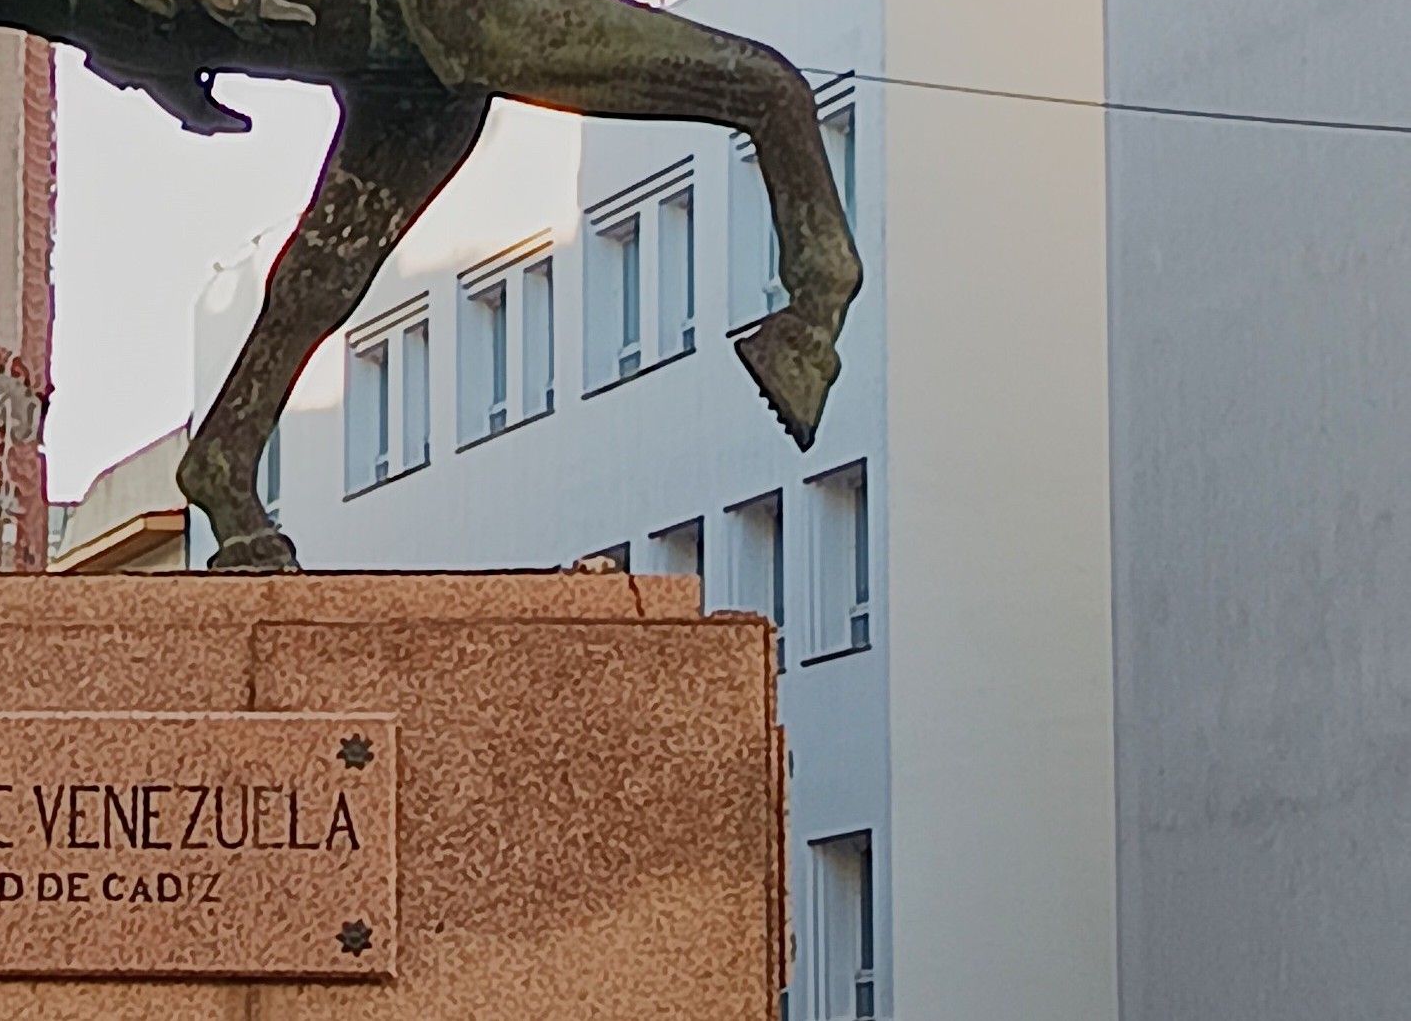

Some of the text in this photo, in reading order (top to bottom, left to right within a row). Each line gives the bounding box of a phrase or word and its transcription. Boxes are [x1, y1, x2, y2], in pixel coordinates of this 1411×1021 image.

[33, 785, 360, 850] VENEZUELA
[37, 872, 90, 902] DE
[102, 872, 221, 903] CADIZ
